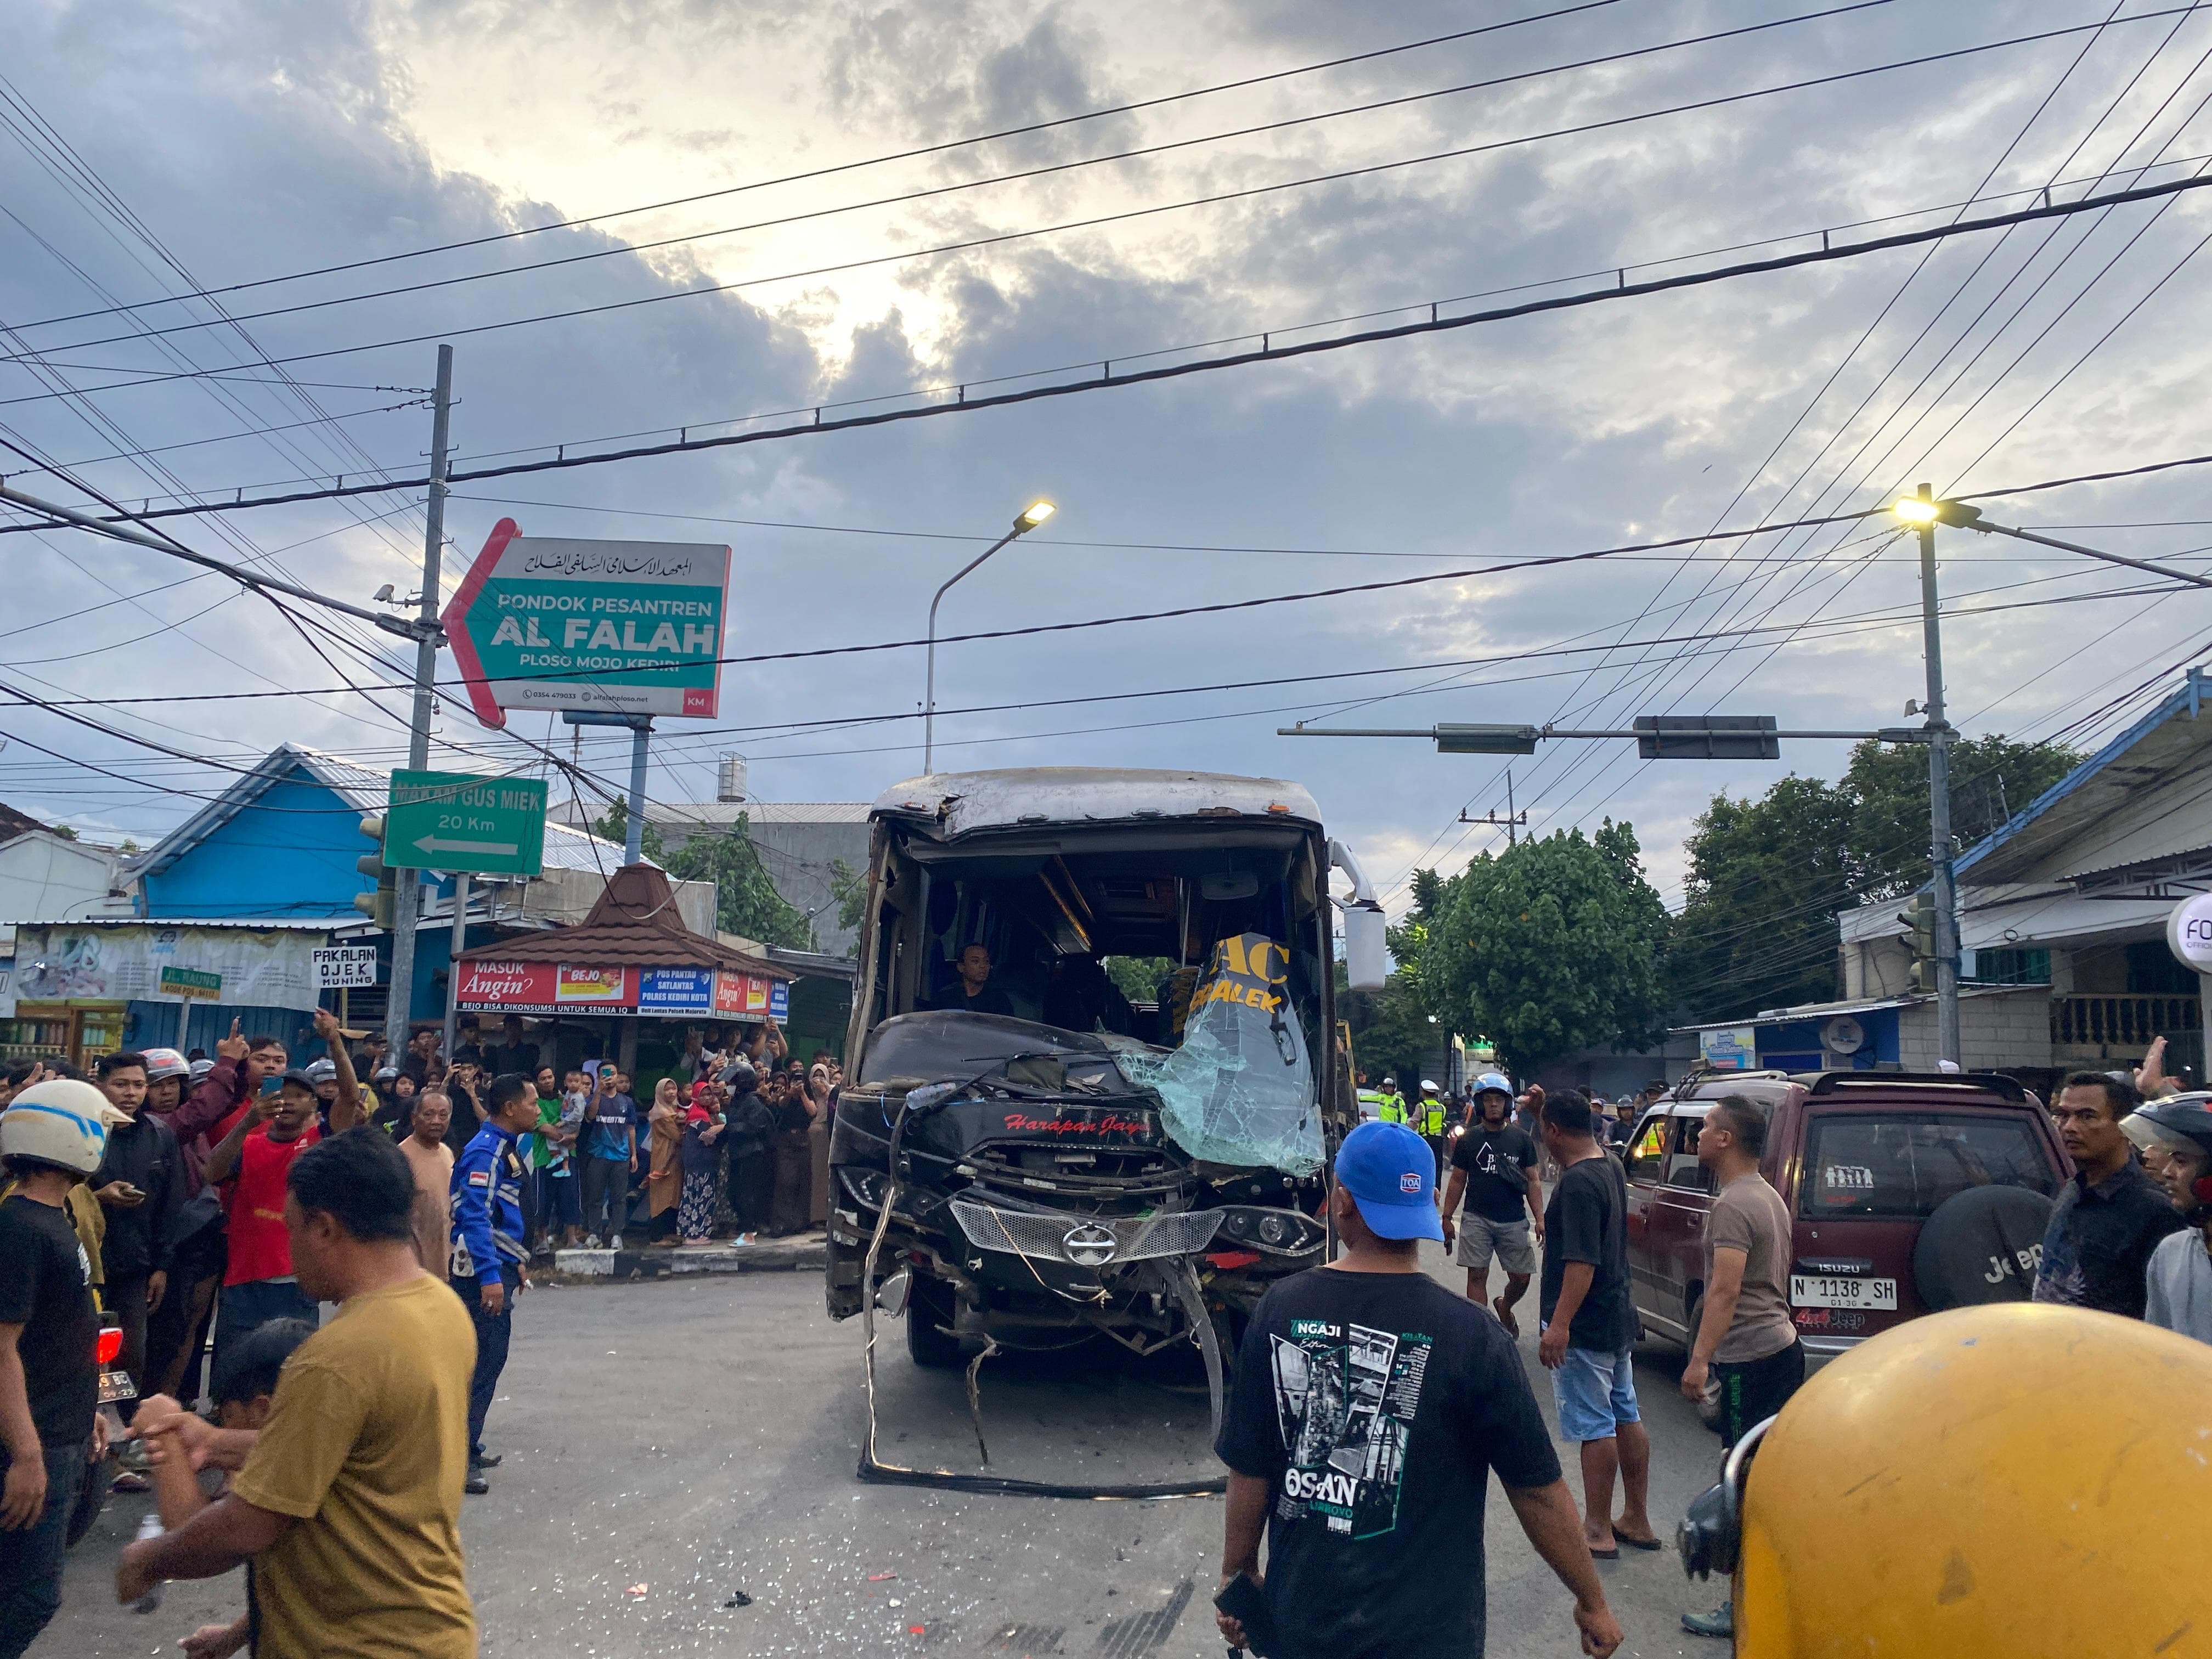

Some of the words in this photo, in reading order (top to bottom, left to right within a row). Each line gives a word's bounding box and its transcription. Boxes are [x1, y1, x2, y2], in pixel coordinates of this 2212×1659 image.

[498, 594, 586, 612] PONDOK
[592, 597, 712, 617] PESANTREN
[490, 616, 550, 647] AL
[564, 618, 714, 654] FALAH
[520, 653, 572, 667] PLOSO
[577, 656, 622, 669] MOJO
[627, 658, 680, 673] KEDIRI
[687, 697, 705, 707] KM
[395, 781, 457, 806] MAKAM
[461, 786, 495, 808] GUS
[500, 789, 540, 812] MIEK
[438, 814, 462, 830] 20
[468, 816, 494, 832] Km
[313, 949, 375, 962] PAKALAN
[1209, 934, 1290, 984] AC
[321, 963, 368, 977] OJEK
[475, 962, 524, 975] MASUK
[571, 969, 600, 981] BEJO
[657, 970, 670, 978] POS
[671, 970, 697, 979] PANTAU
[461, 974, 533, 1001] Angin?
[658, 981, 694, 990] SATLANTAS
[642, 992, 667, 1001] POLRES
[668, 993, 690, 1001] KEDIRI
[691, 994, 708, 1002] KOTA
[716, 981, 742, 1008] Angin?
[504, 1003, 555, 1012] DIKONSUMSI
[1004, 1114, 1096, 1134] Harapan
[1403, 1178, 1419, 1187] TOA
[1819, 1263, 1860, 1273] ISUZU
[1795, 1279, 1804, 1296] N
[1819, 1280, 1860, 1297] 1138
[1874, 1282, 1894, 1299] SH
[1830, 1308, 1865, 1327] Jeep
[1297, 1323, 1341, 1338] NGAJI
